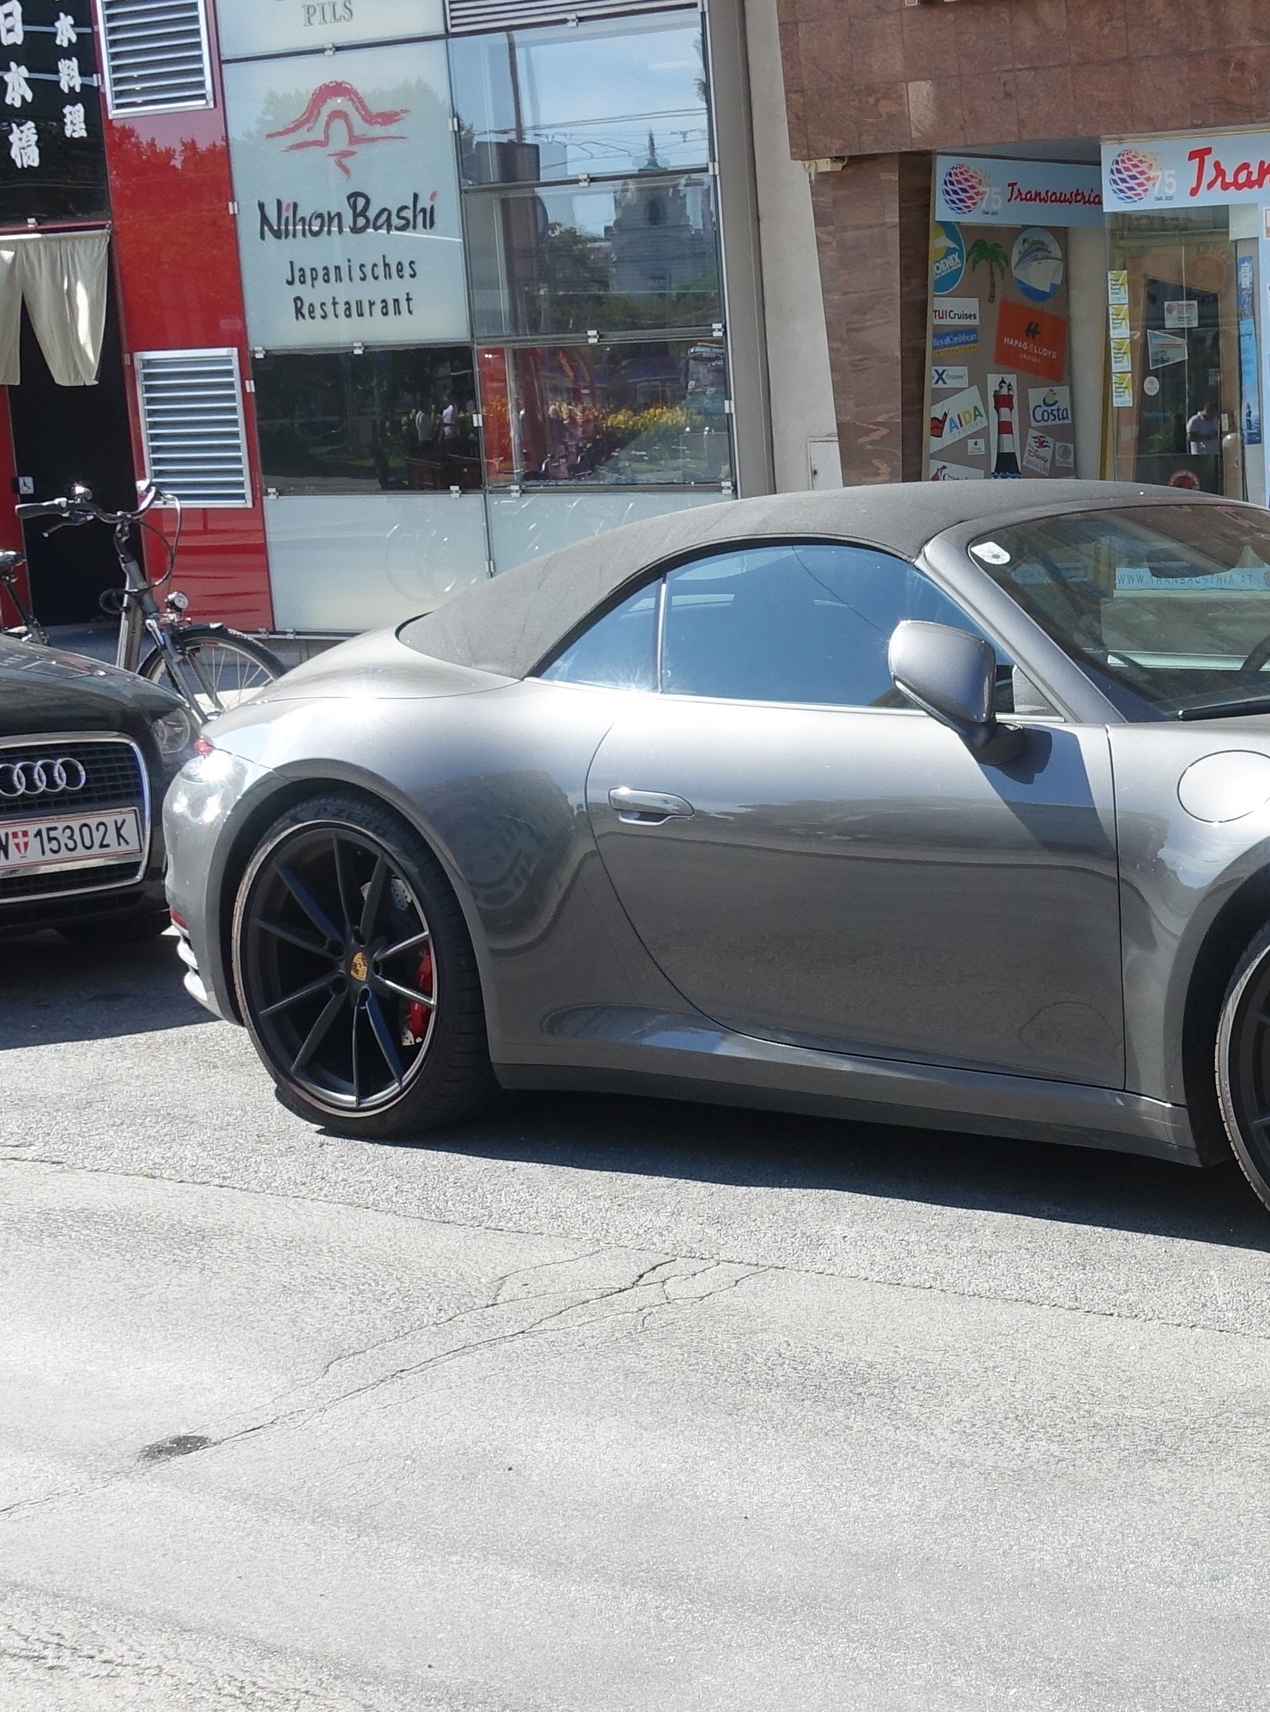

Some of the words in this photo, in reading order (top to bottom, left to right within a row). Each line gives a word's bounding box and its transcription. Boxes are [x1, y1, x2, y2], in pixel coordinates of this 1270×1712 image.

[302, 1, 353, 27] PILS
[1006, 180, 1103, 206] Transaustria
[1150, 169, 1177, 195] 75
[257, 197, 344, 241] Nihon
[346, 191, 438, 234] Bashi
[285, 254, 417, 288] Japanisches
[934, 252, 961, 274] OENIX
[293, 292, 413, 321] Restaurant
[948, 310, 978, 320] Cruises
[1003, 336, 1028, 350] HAPAG
[1033, 345, 1057, 359] LLOYD
[948, 404, 983, 434] AIDA
[1032, 404, 1070, 423] Costa
